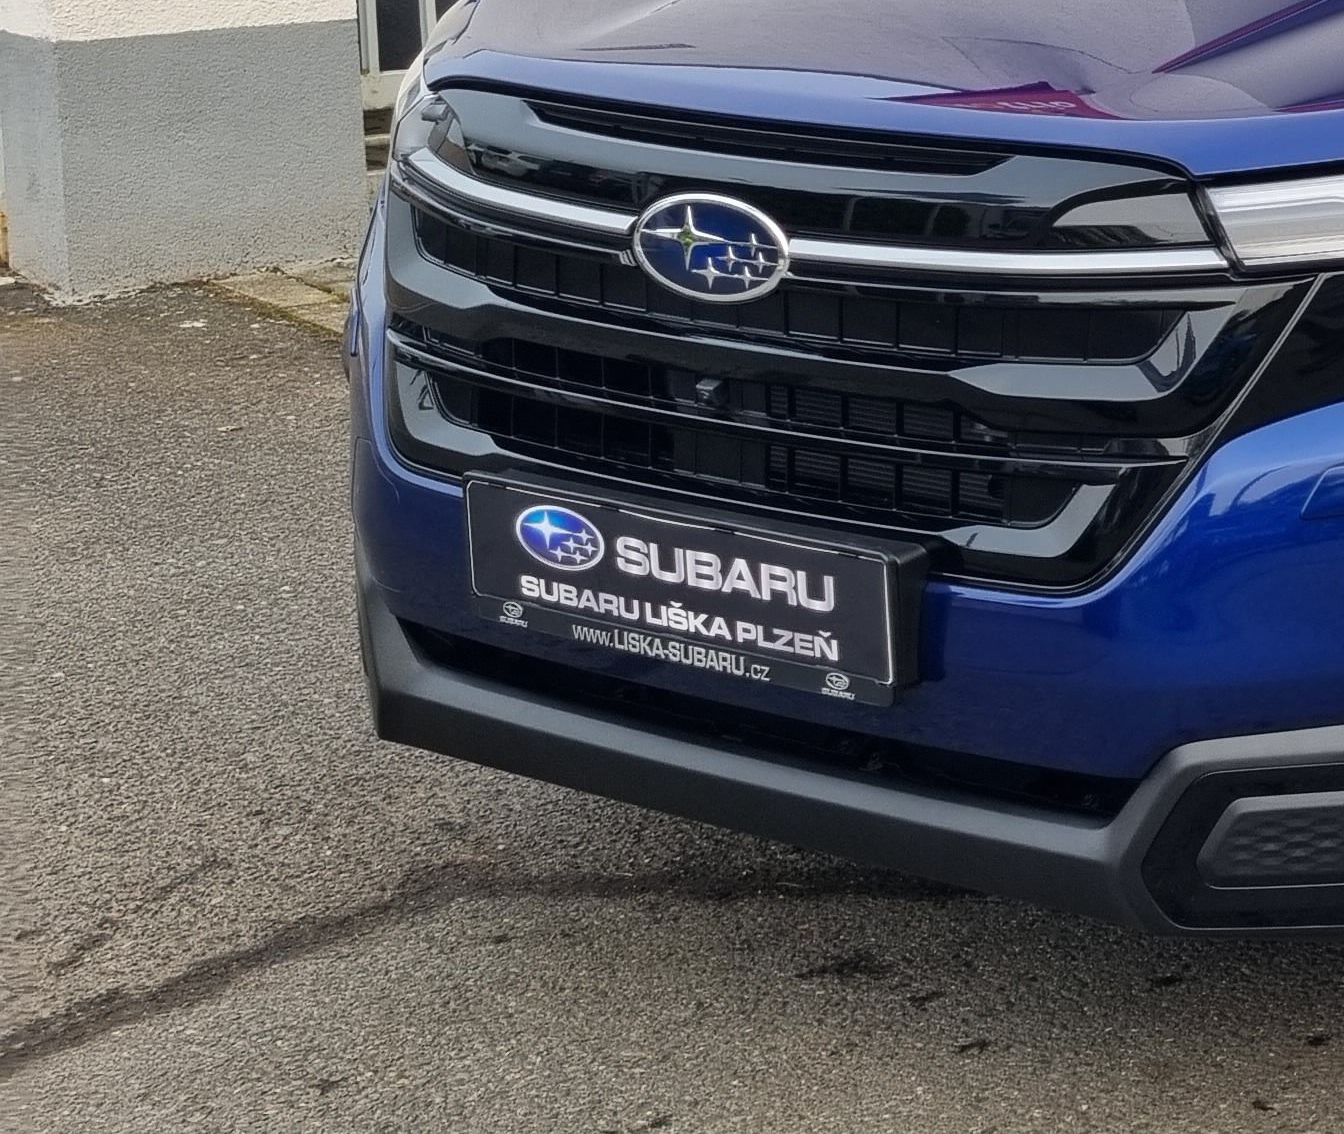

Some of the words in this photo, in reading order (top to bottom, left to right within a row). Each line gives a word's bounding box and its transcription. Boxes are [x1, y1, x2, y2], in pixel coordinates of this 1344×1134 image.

[616, 537, 835, 613] SUBARU
[499, 615, 528, 628] SUBARU
[521, 576, 639, 621] SUBARU
[645, 601, 732, 642] LIŠKA
[737, 621, 838, 662] PLZEŇ
[572, 625, 771, 682] www.LISKA-SUBARU.cz
[821, 687, 856, 701] SUBARU
